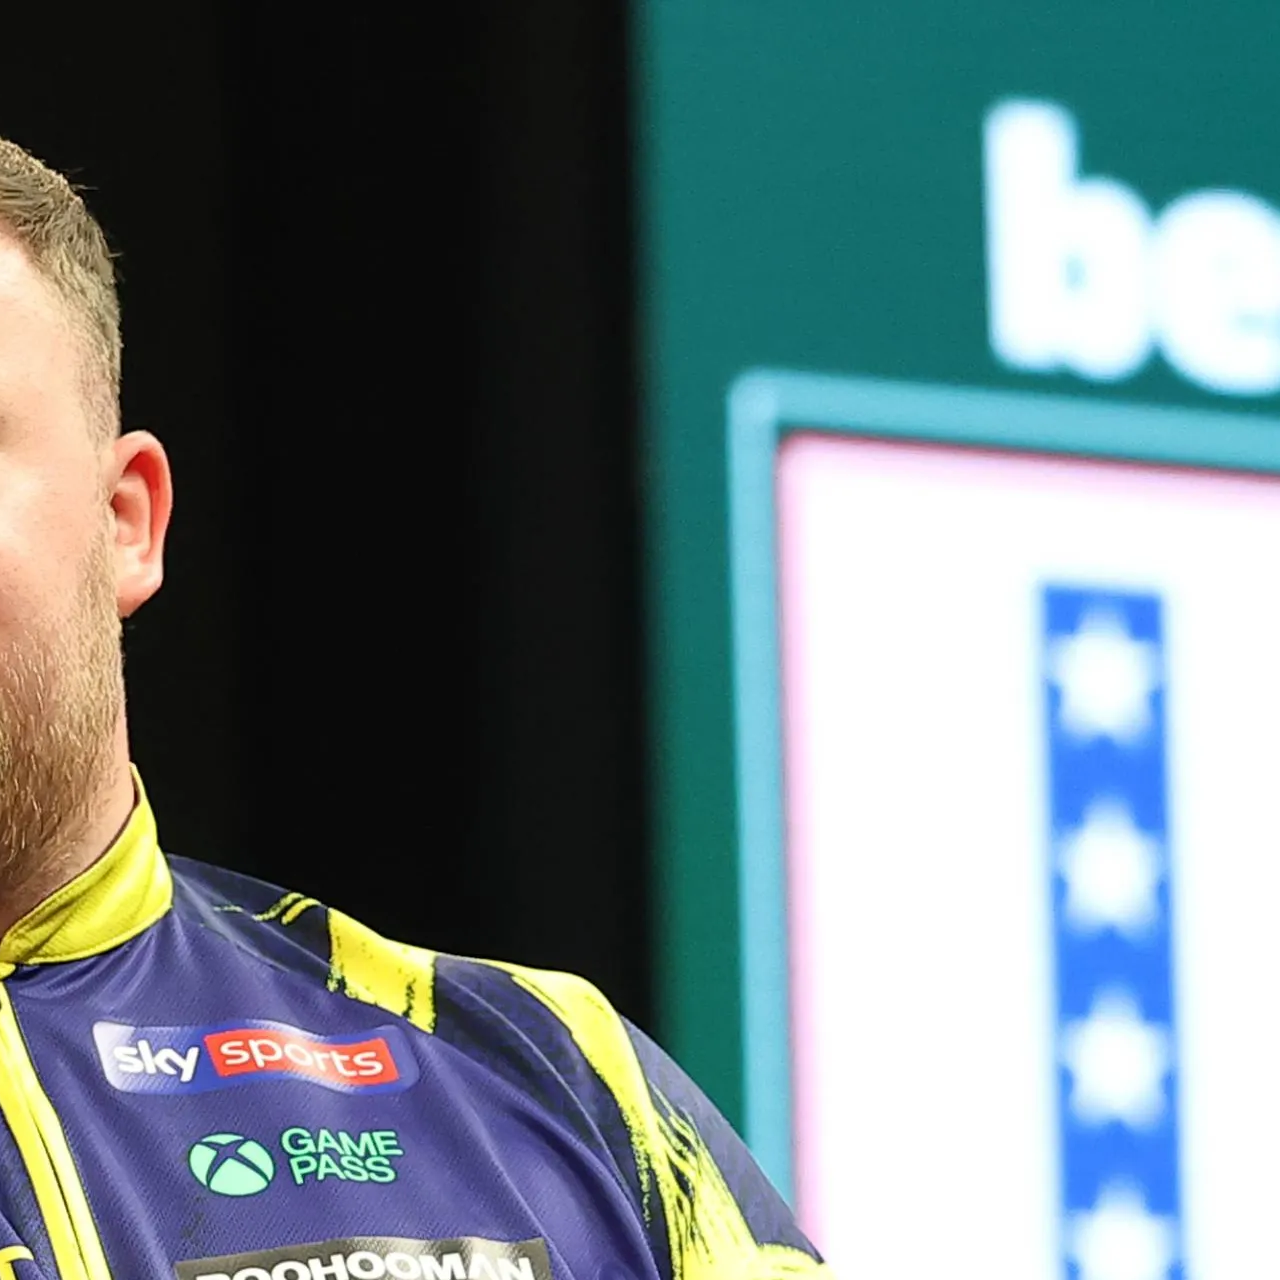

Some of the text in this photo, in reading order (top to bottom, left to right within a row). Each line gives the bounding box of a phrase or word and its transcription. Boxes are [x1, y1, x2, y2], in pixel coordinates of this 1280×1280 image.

[113, 1037, 384, 1083] sky sports
[280, 1126, 404, 1158] GAME
[287, 1154, 397, 1185] PASS
